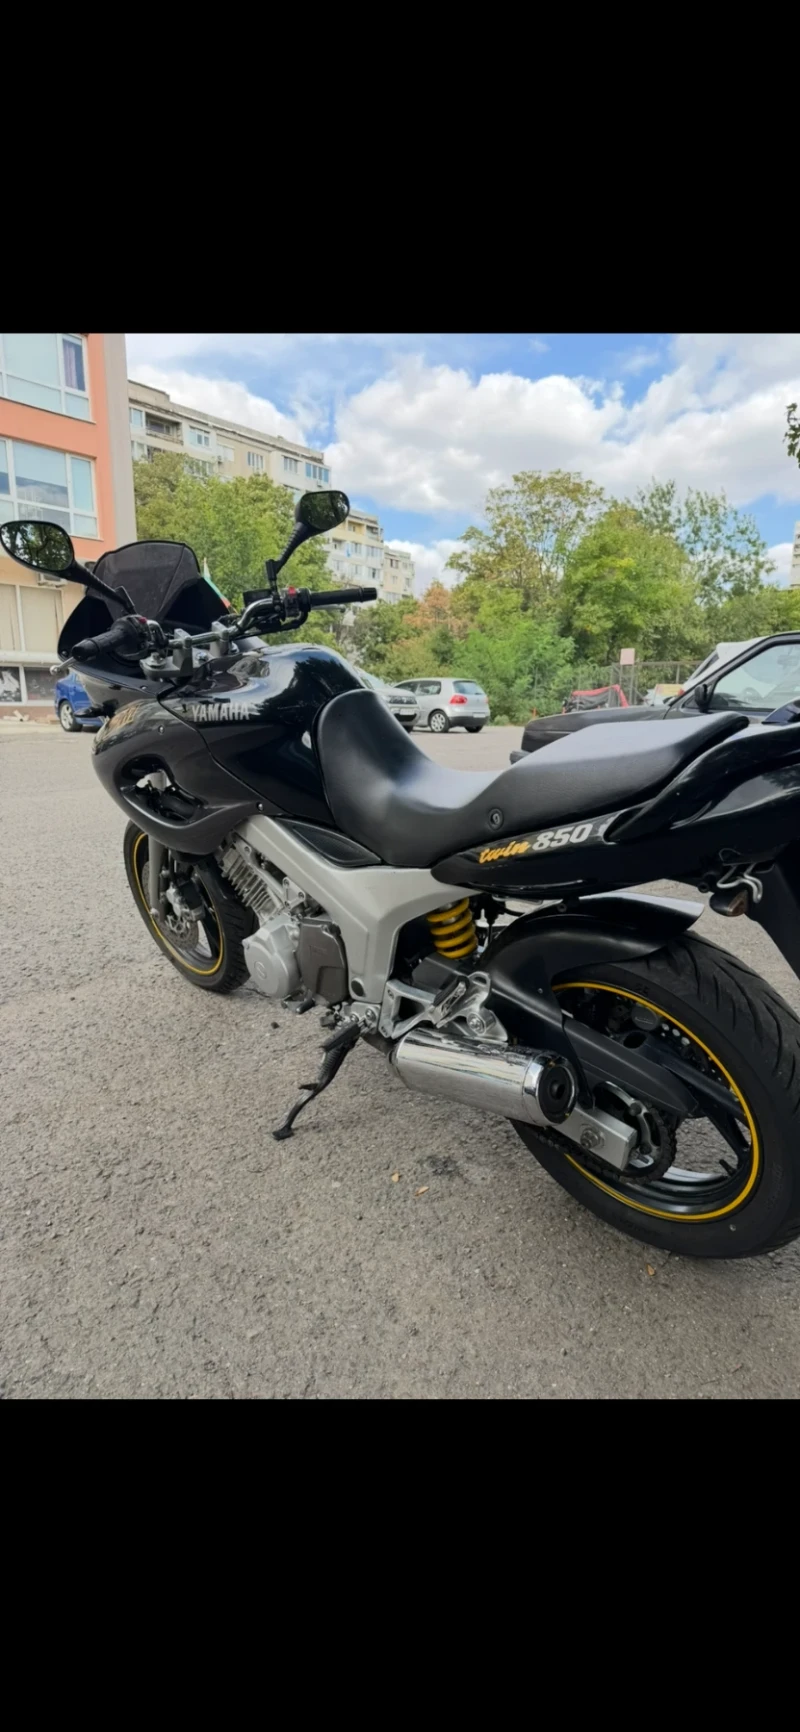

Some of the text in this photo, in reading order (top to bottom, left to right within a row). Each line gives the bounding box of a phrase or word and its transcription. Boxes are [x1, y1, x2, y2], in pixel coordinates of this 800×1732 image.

[191, 702, 250, 722] YAMAHA
[479, 823, 594, 863] twin 850
